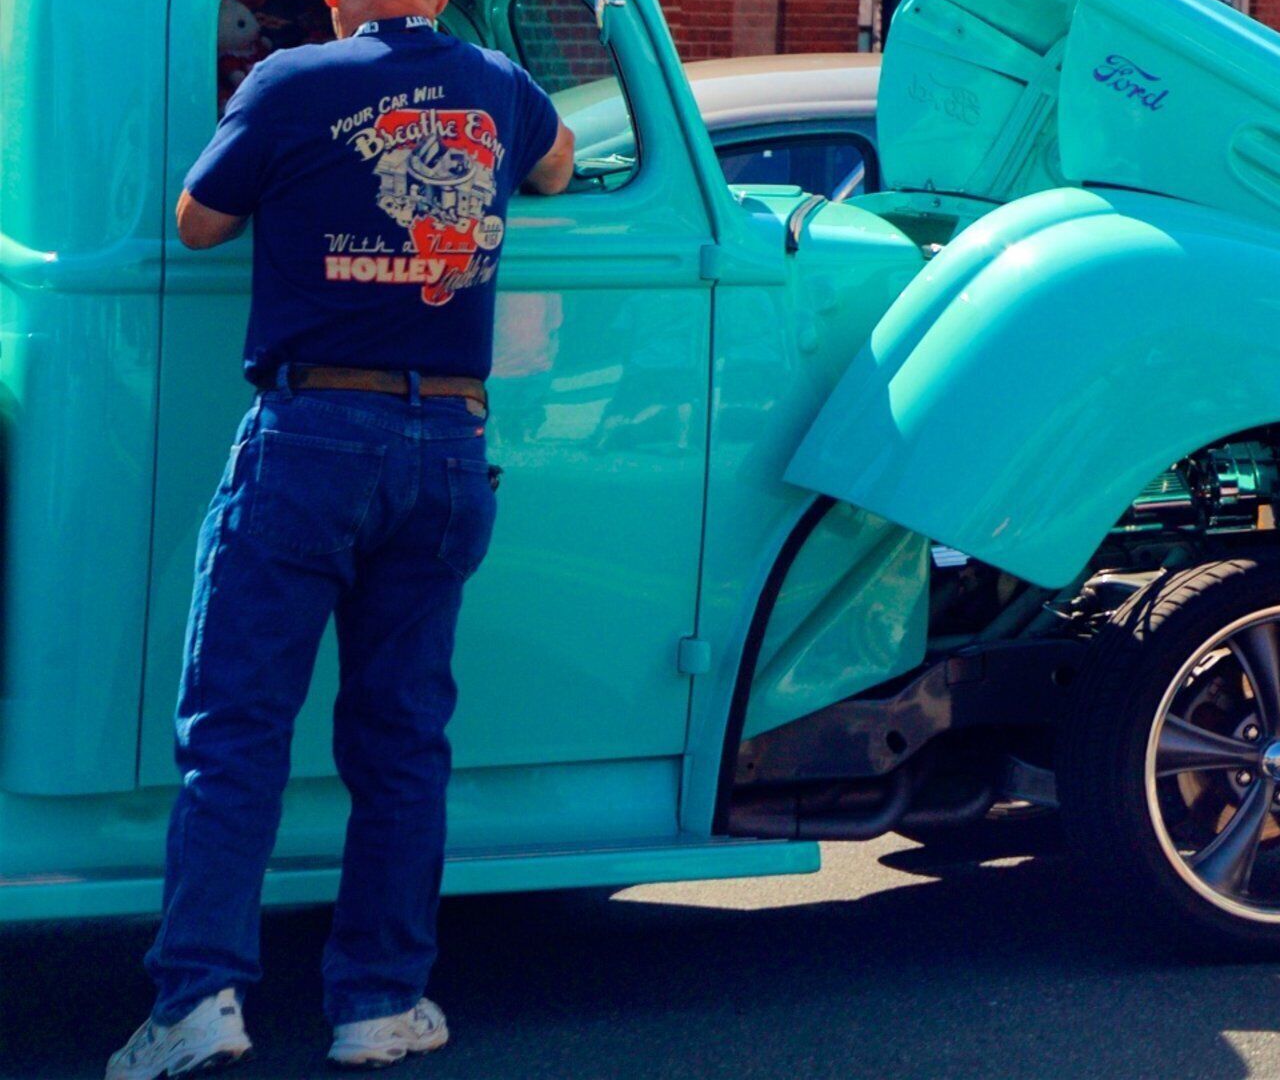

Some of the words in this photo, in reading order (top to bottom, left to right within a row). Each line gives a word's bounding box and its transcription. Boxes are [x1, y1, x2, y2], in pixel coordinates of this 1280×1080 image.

[1093, 54, 1169, 111] Ford
[329, 106, 374, 140] YOUR
[378, 93, 409, 114] CAR
[413, 85, 446, 104] WILL
[346, 108, 458, 162] Breathe
[464, 112, 506, 170] Easy
[324, 233, 395, 253] With
[402, 240, 419, 253] a
[325, 256, 447, 284] HOLLEY
